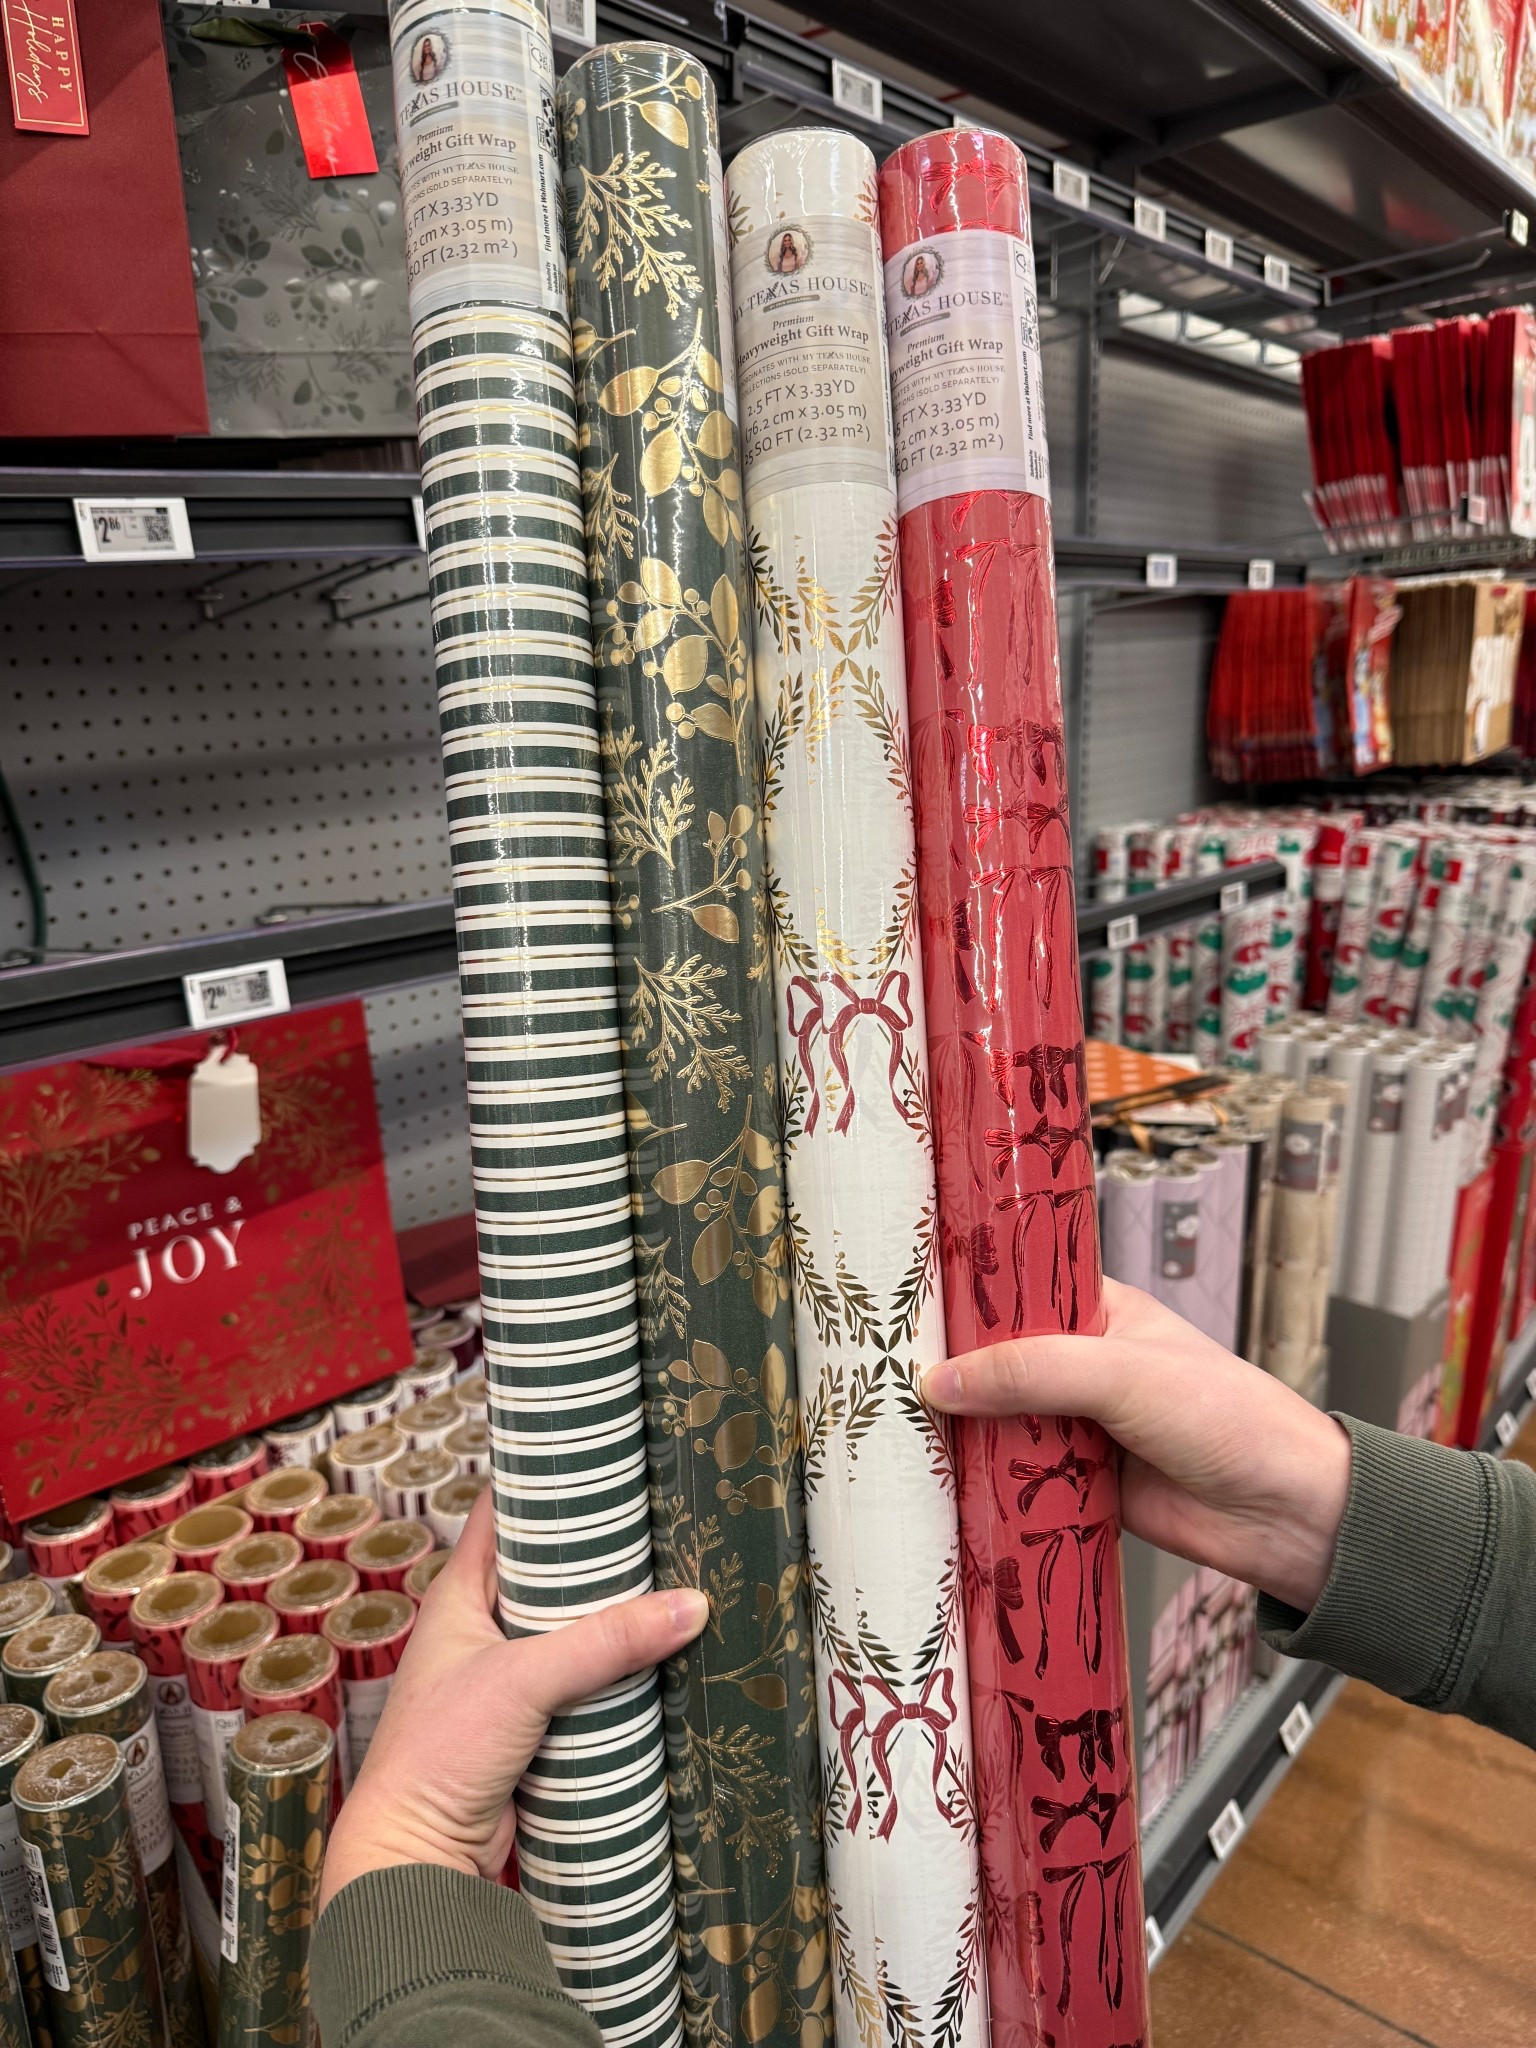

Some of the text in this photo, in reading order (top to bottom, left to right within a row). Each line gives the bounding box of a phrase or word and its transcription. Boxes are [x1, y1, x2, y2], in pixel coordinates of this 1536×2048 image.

[9, 0, 53, 104] Holidays
[51, 16, 73, 92] HAPPY
[400, 87, 440, 126] TEXAS
[416, 125, 454, 145] Premium
[446, 133, 475, 149] Gift
[478, 133, 517, 153] Wrap
[421, 170, 441, 184] WITH
[443, 165, 455, 175] MY
[456, 161, 486, 171] TEXAS
[488, 163, 520, 175] HOUSE
[451, 175, 513, 186] SEPARATELY)
[538, 154, 547, 204] Walmart.com
[413, 206, 426, 228] FT
[428, 200, 439, 217] X
[542, 205, 548, 214] at
[420, 229, 437, 246] cm
[452, 219, 487, 238] 3.05
[544, 235, 552, 252] Find
[422, 249, 438, 269] FT
[440, 242, 480, 263] (2.32
[747, 279, 800, 310] TEXAS
[772, 315, 814, 330] Premium
[888, 300, 932, 336] TEXAS
[736, 325, 869, 368] Heavyweight Gift Wrap
[907, 333, 945, 353] Premium
[937, 340, 965, 356] Gift
[967, 338, 1004, 353] Wrap
[777, 356, 799, 368] WITH
[802, 354, 814, 362] MY
[817, 351, 844, 360] TEXAS
[846, 353, 871, 365] HOUSE
[812, 364, 866, 375] SEPARATELY)
[911, 375, 931, 388] WITH
[933, 371, 945, 380] MY
[947, 365, 975, 376] TEXAS
[977, 365, 1006, 373] HOUSE
[942, 376, 999, 389] SEPARATELY)
[1022, 351, 1030, 396] Walmart.com
[747, 399, 763, 417] 2.5
[765, 387, 782, 406] FT
[785, 383, 797, 400] X
[1025, 397, 1031, 405] at
[745, 419, 770, 444] (76.2
[773, 410, 794, 425] cm
[810, 404, 845, 420] 3.05
[848, 404, 867, 420] m)
[902, 408, 916, 428] FT
[918, 402, 929, 420] X
[755, 437, 772, 457] SQ
[775, 429, 794, 447] FT
[797, 426, 838, 443] (2.32
[908, 429, 926, 446] cm
[941, 417, 975, 437] 3.05
[911, 447, 926, 467] FT
[929, 440, 968, 461] (2.32
[127, 1195, 243, 1241] PEACE &
[129, 1218, 247, 1300] JOY
